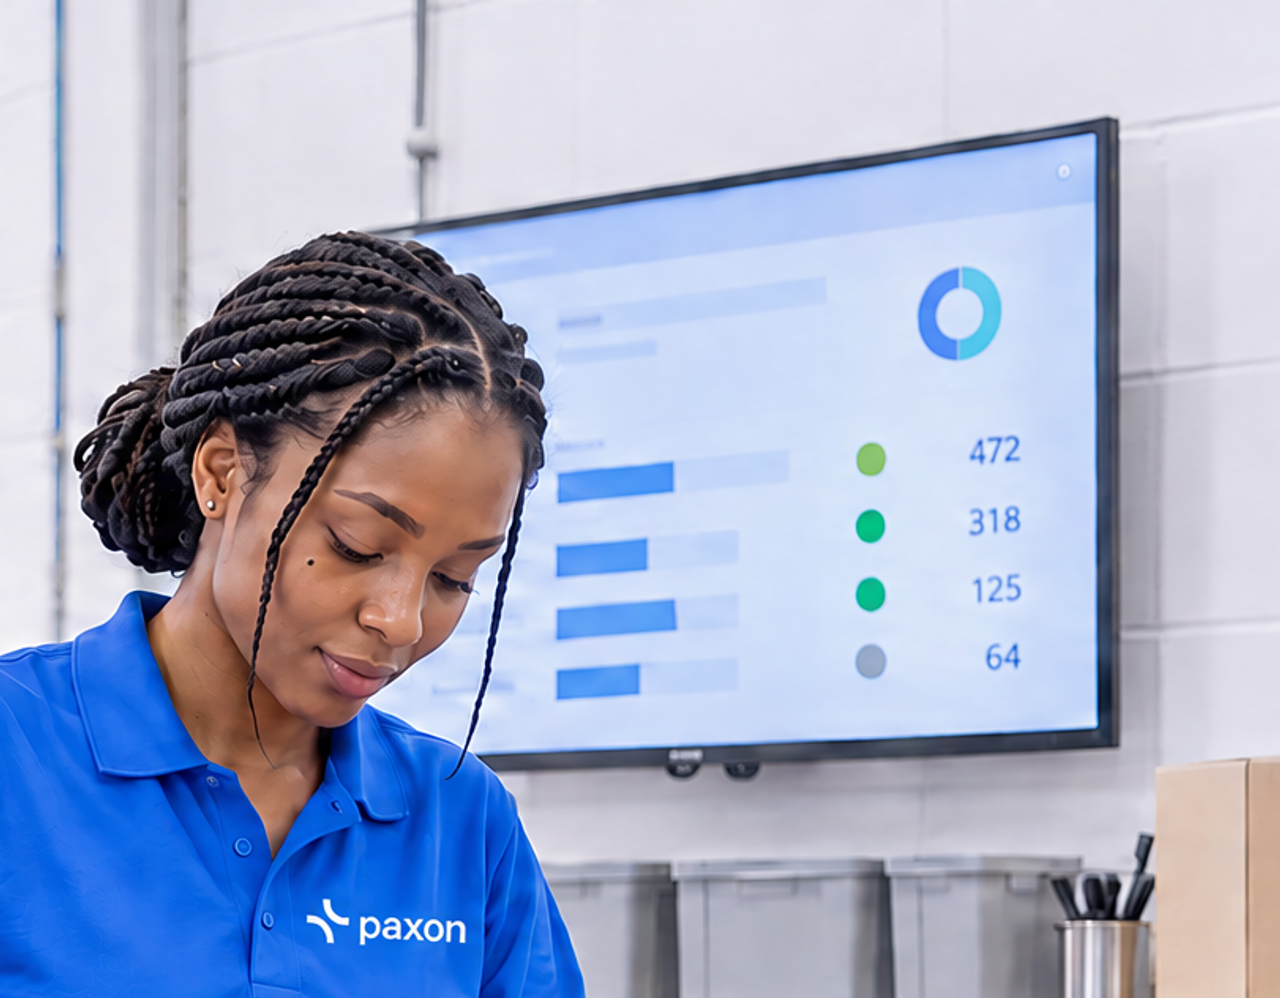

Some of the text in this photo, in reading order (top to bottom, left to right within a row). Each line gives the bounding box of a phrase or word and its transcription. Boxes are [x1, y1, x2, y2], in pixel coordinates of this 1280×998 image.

[969, 435, 1021, 465] 472
[969, 505, 1021, 536] 318
[972, 574, 1022, 603] 125
[985, 643, 1021, 671] 64
[359, 916, 466, 946] paxon
